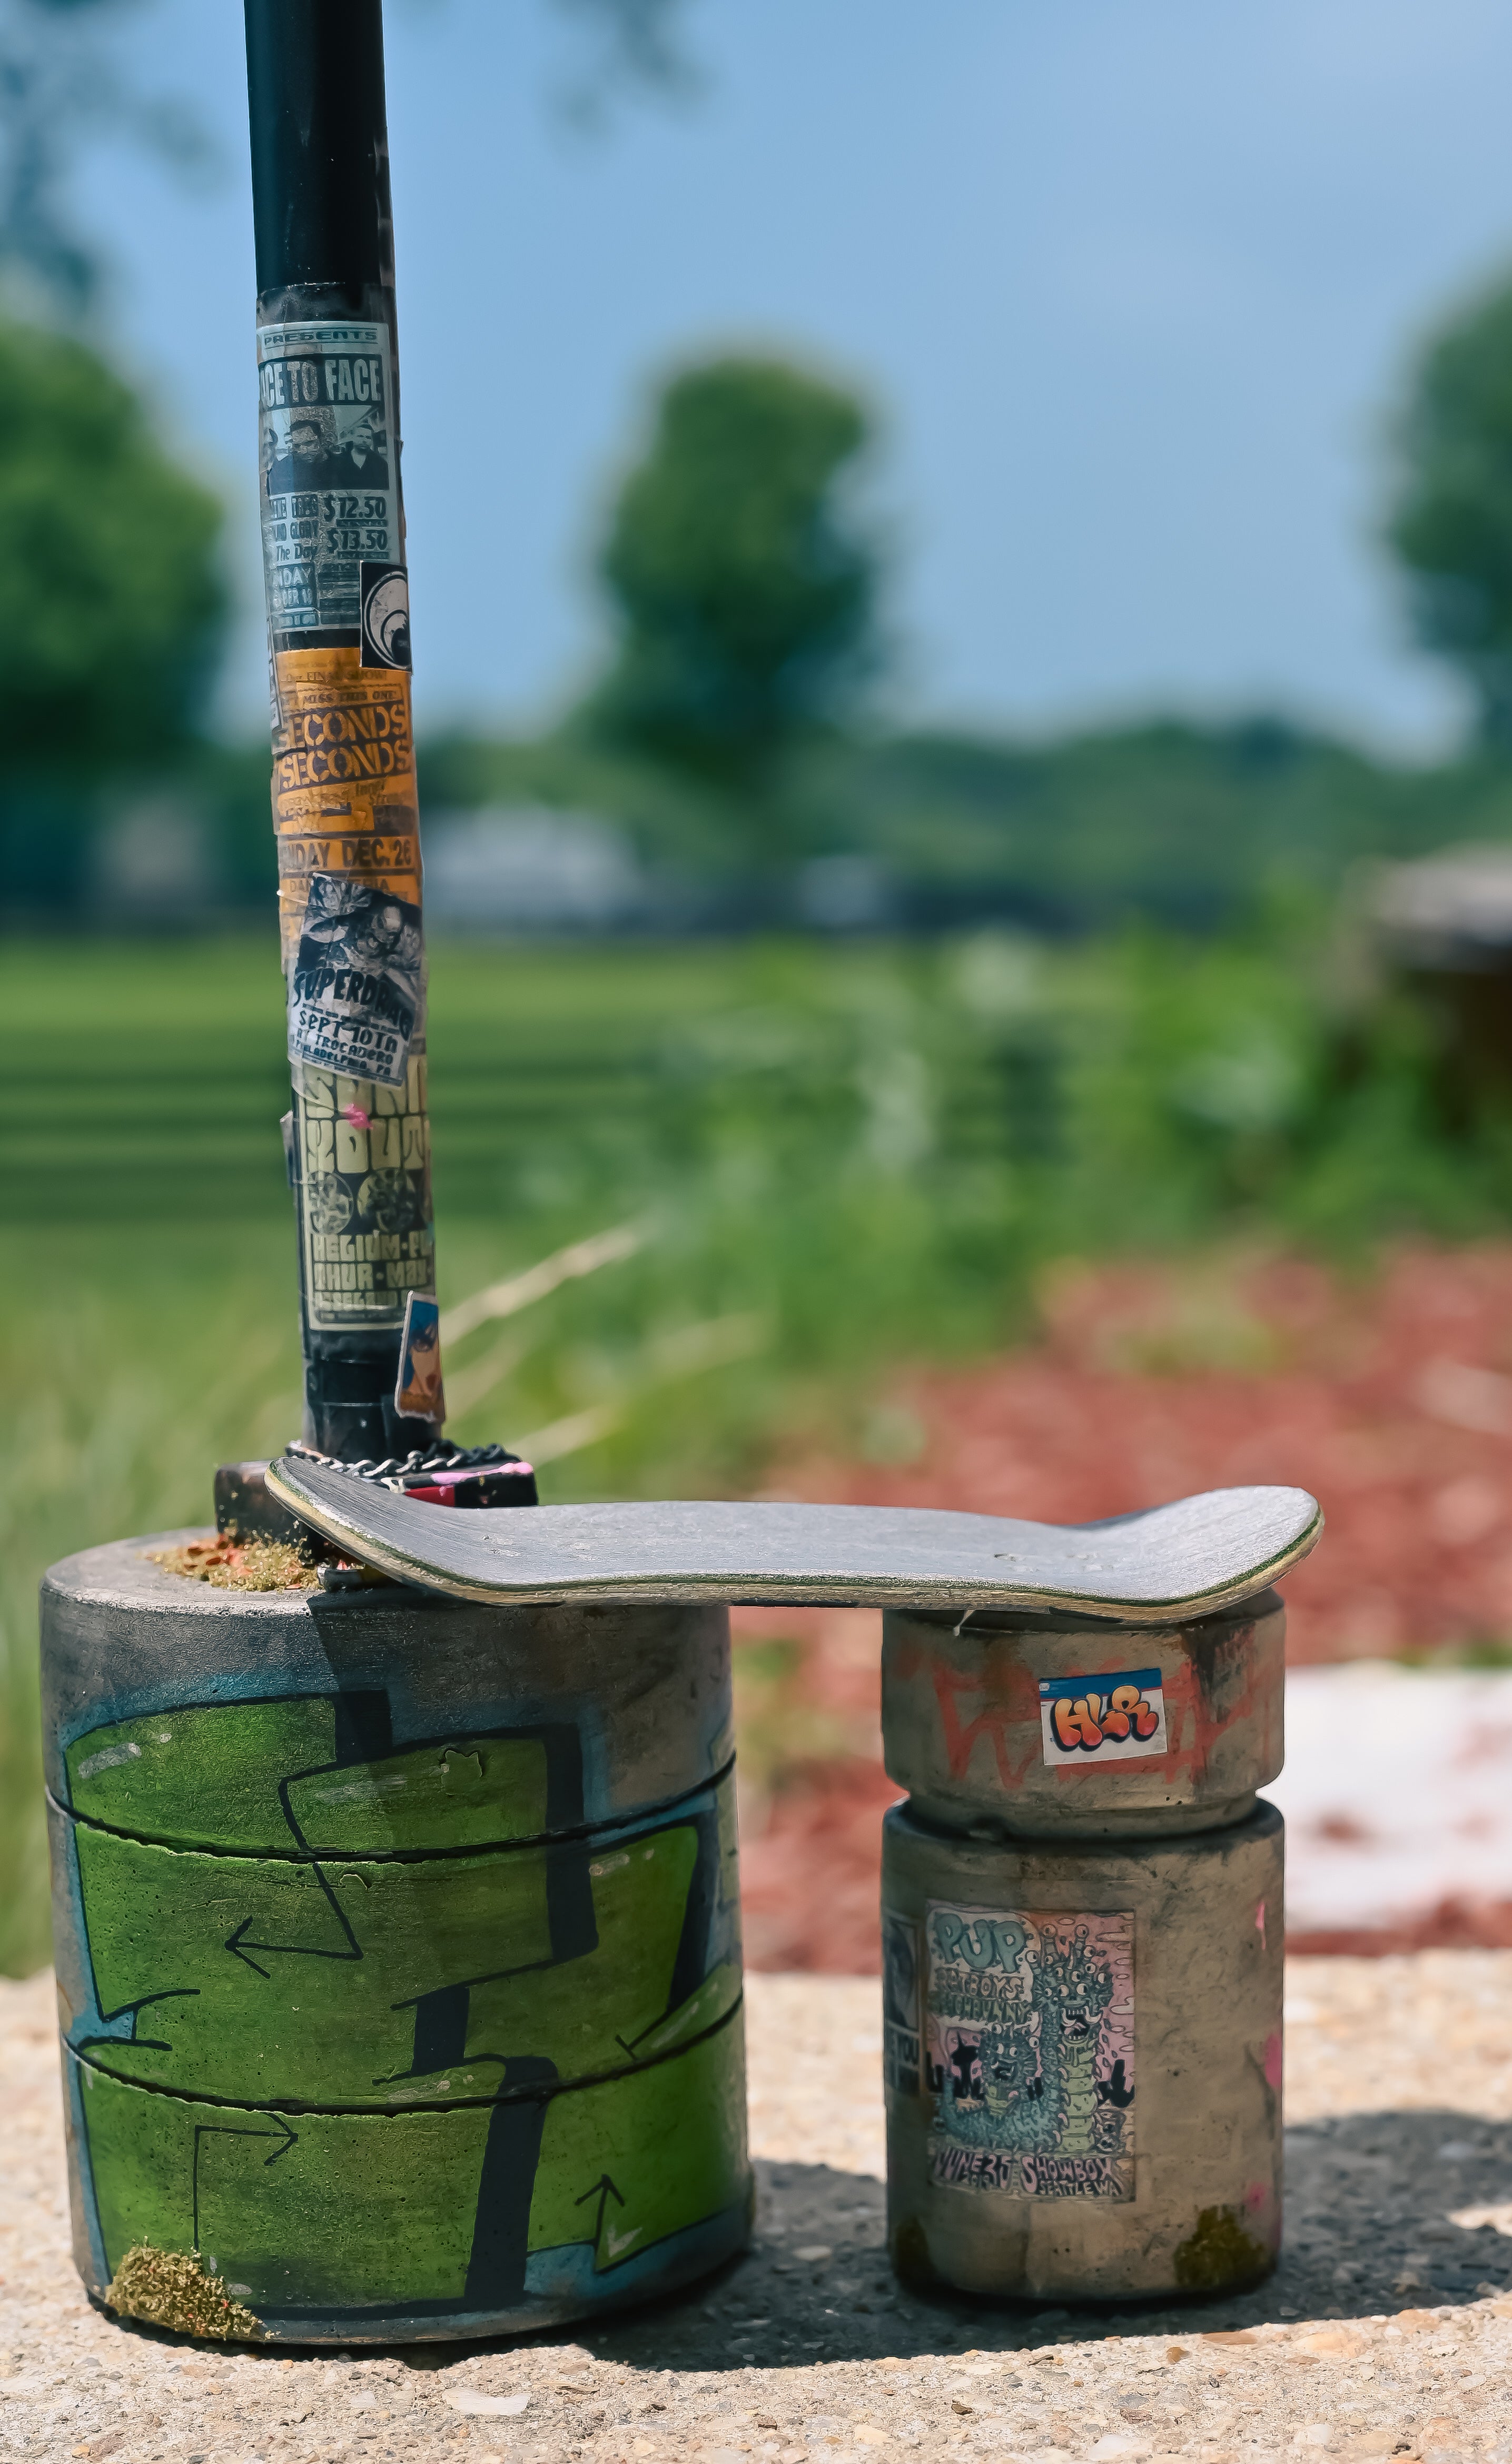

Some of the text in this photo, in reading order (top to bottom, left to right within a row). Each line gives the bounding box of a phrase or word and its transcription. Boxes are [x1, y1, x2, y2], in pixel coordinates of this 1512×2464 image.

[264, 331, 377, 346] PRESENTS
[287, 361, 318, 403] TO
[324, 359, 381, 401] FACE
[322, 495, 387, 522] $12.50
[325, 528, 388, 553] $13.50
[280, 740, 410, 789] SECONDS
[313, 1234, 401, 1261] HELIUM
[935, 1912, 1026, 1973] PUP
[1020, 2155, 1125, 2193] SHOWBOX
[1040, 2181, 1094, 2196] SEATTLE
